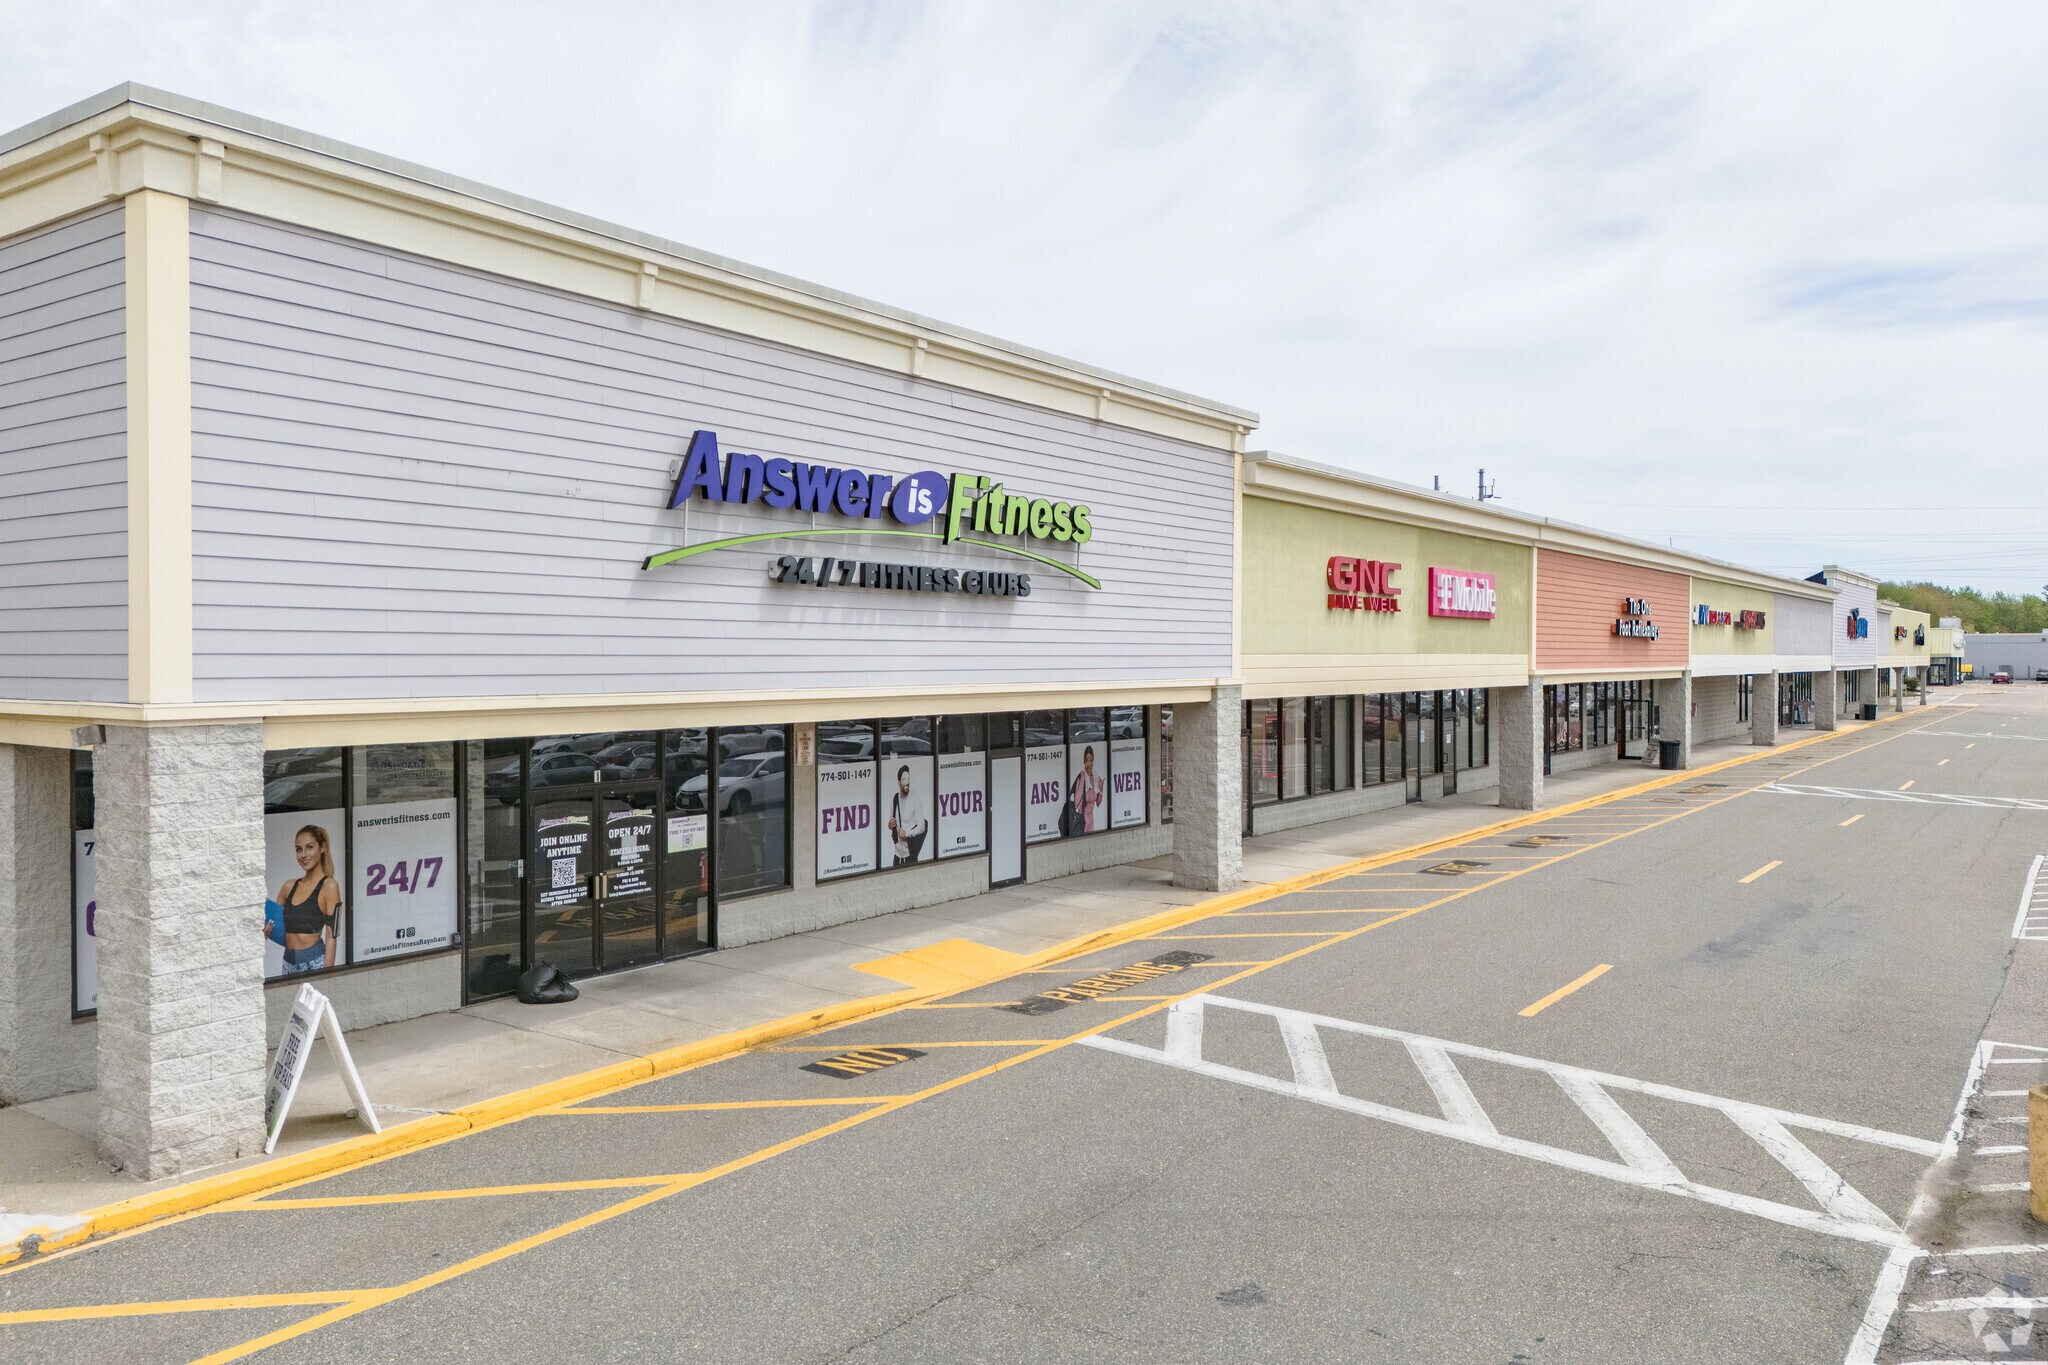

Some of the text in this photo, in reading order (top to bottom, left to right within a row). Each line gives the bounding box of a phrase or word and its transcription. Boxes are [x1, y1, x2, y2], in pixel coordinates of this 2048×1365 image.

[666, 430, 1093, 545] Answer is Fitness
[777, 556, 1031, 597] 24/7 FITNESS CLUBS
[1327, 556, 1401, 595] GNC
[1328, 594, 1401, 613] LIVE WELL
[1626, 597, 1640, 615] The
[1027, 751, 1063, 762] 774-501-1447
[821, 769, 871, 782] 774-501-1447
[1114, 771, 1141, 793] WER
[939, 790, 983, 817] YOUR
[1031, 780, 1059, 805] ANS
[357, 811, 450, 828] answerisfitness.com
[822, 804, 871, 835] FIND
[541, 833, 588, 848] JOIN ONLINE
[609, 824, 652, 839] OPEN 24/7
[547, 845, 582, 858] ANYTIME
[366, 856, 443, 897] 24/7
[363, 935, 447, 957] @AnswerIsFitnessRaynham
[1036, 962, 1182, 1003] PARKING
[815, 1050, 909, 1074] NO
